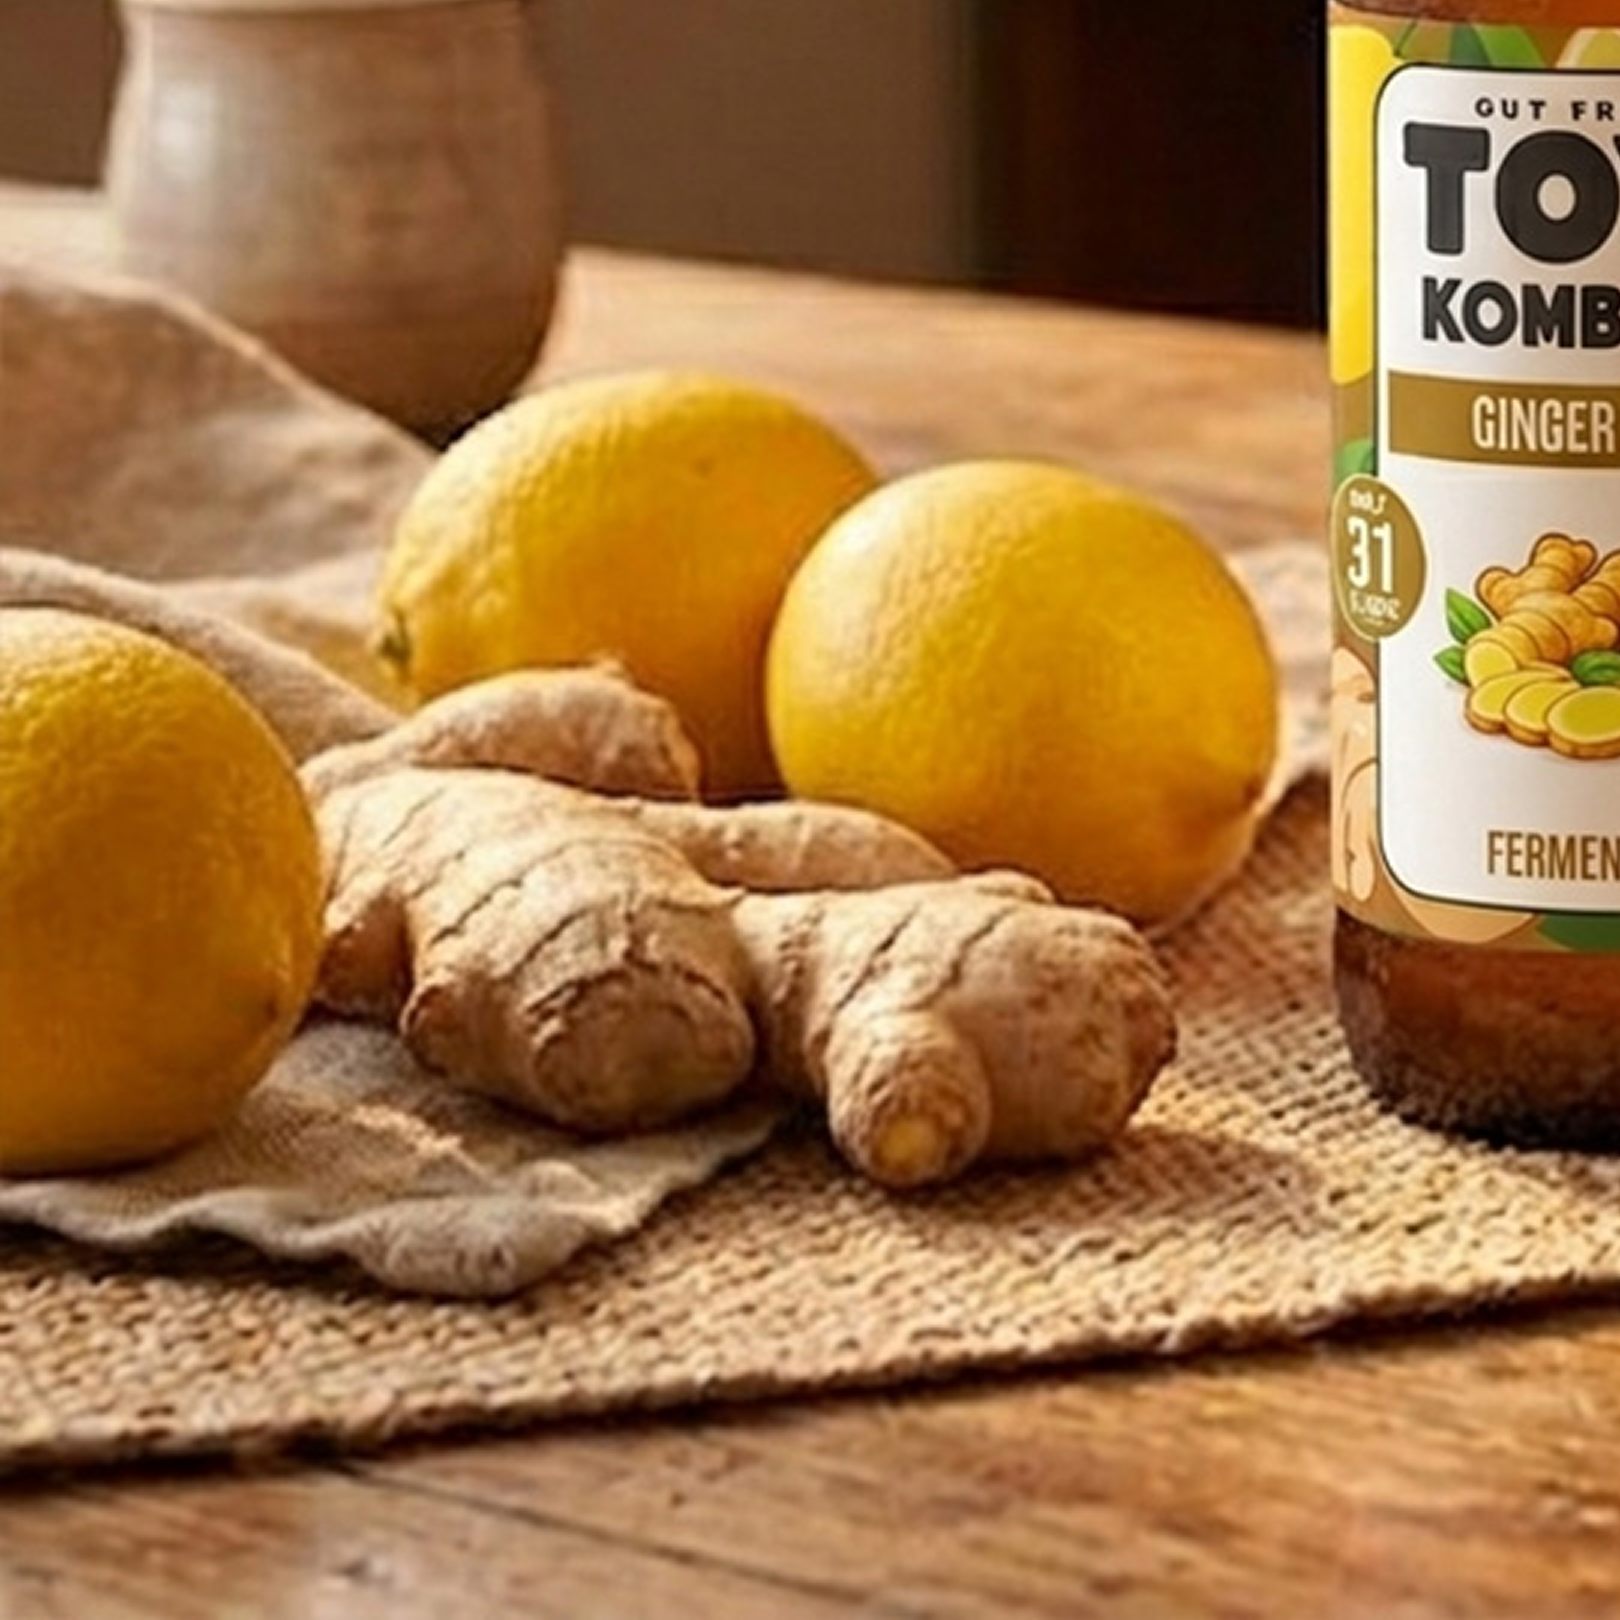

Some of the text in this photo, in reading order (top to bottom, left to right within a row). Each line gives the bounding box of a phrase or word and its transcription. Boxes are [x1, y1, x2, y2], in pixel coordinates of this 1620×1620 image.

[1475, 97, 1546, 120] GUT
[1471, 394, 1614, 453] GINGER
[1347, 516, 1393, 593] 31
